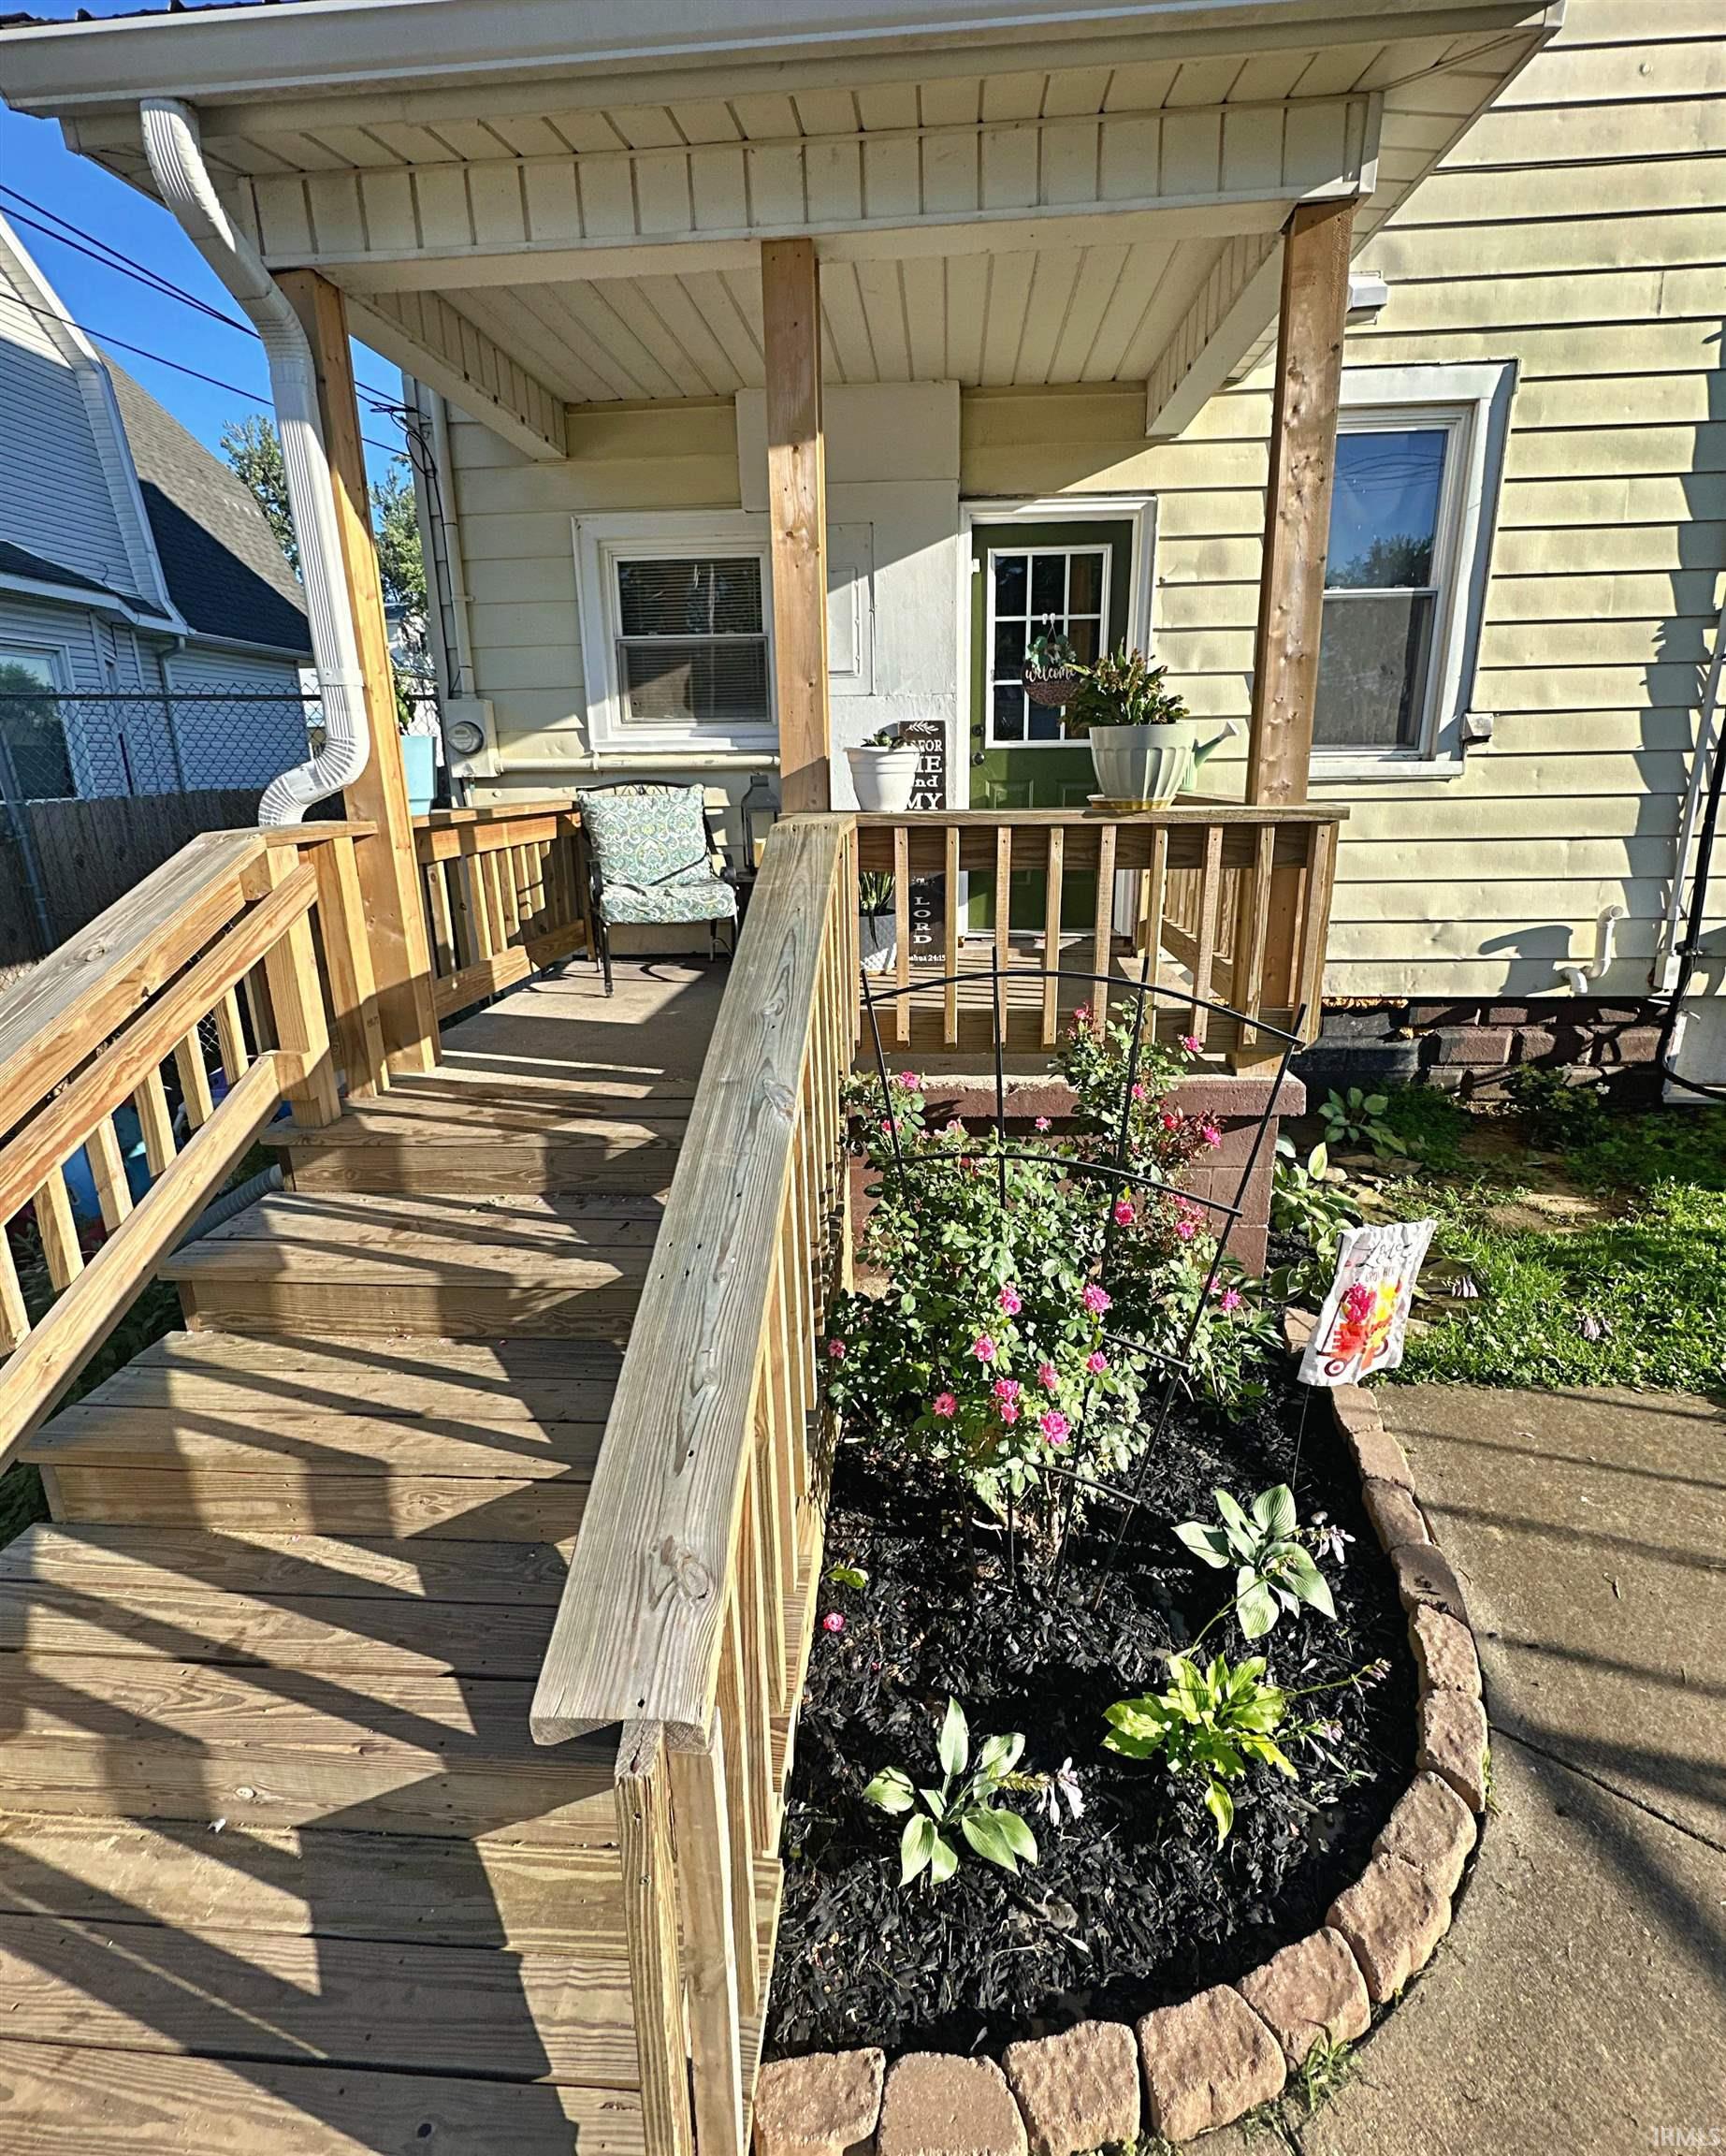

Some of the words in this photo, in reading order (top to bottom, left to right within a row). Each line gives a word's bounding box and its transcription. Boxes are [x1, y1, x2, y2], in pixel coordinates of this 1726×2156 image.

[919, 739, 943, 752] FOR
[914, 775, 938, 787] nd
[913, 896, 933, 944] LORD
